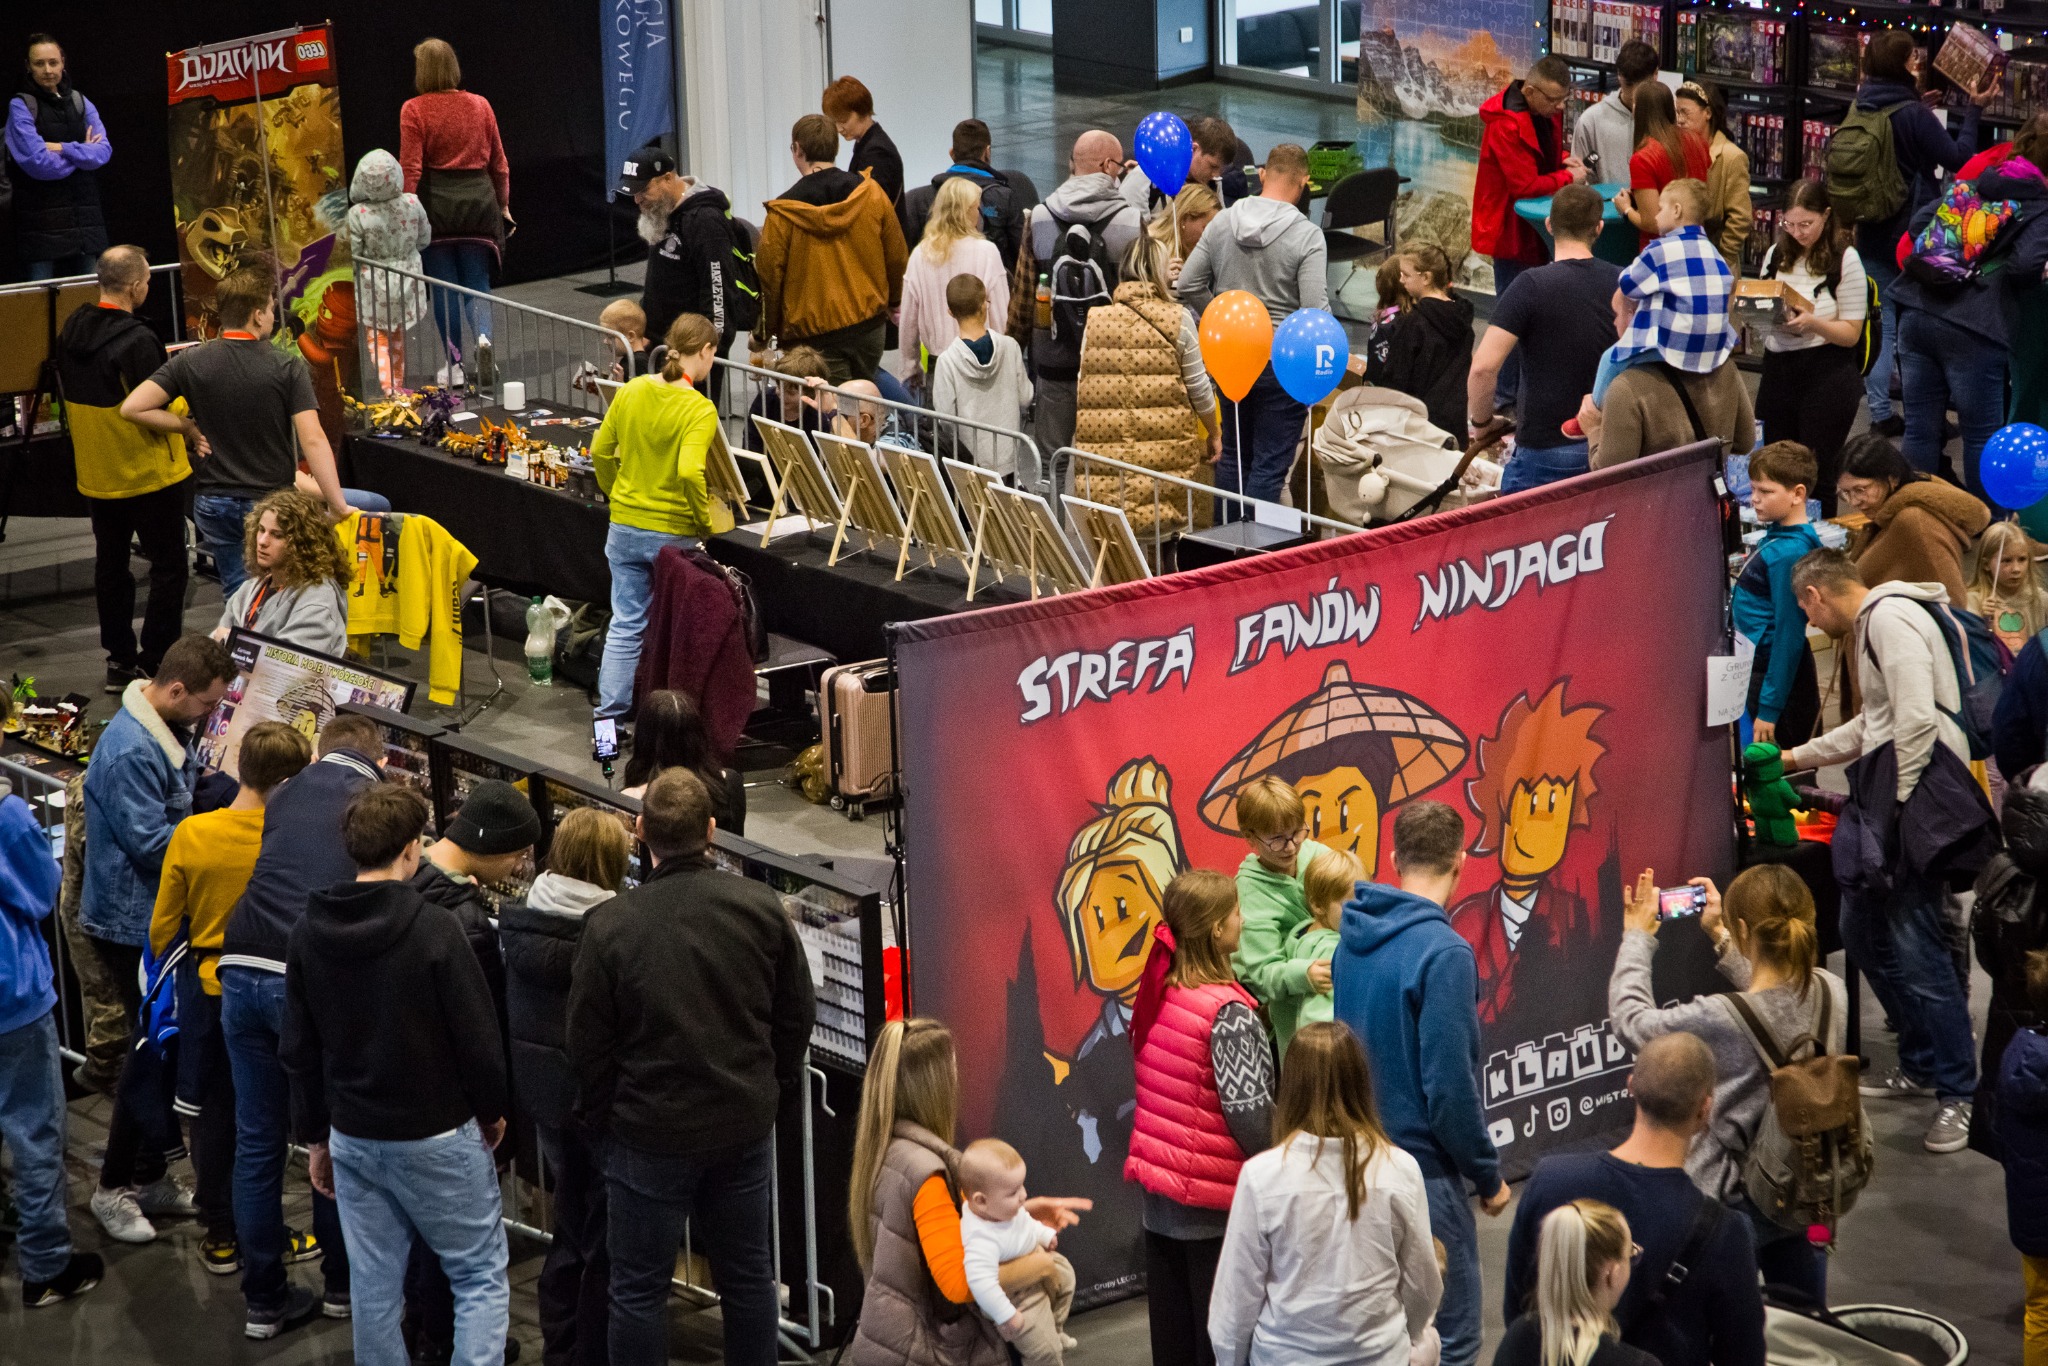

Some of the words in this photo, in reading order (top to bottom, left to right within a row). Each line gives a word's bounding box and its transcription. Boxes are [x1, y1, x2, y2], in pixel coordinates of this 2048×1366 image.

[1016, 625, 1195, 724] STREFA
[1230, 576, 1381, 674] FANÓW
[1413, 512, 1616, 631] NINJAGO
[264, 646, 299, 668] HISTORIA
[300, 657, 325, 675] MOJEJ
[327, 665, 377, 690] TWÓRCZOŚCI
[1489, 1029, 1637, 1099] KLAUD
[1579, 1089, 1635, 1115] @MISTR
